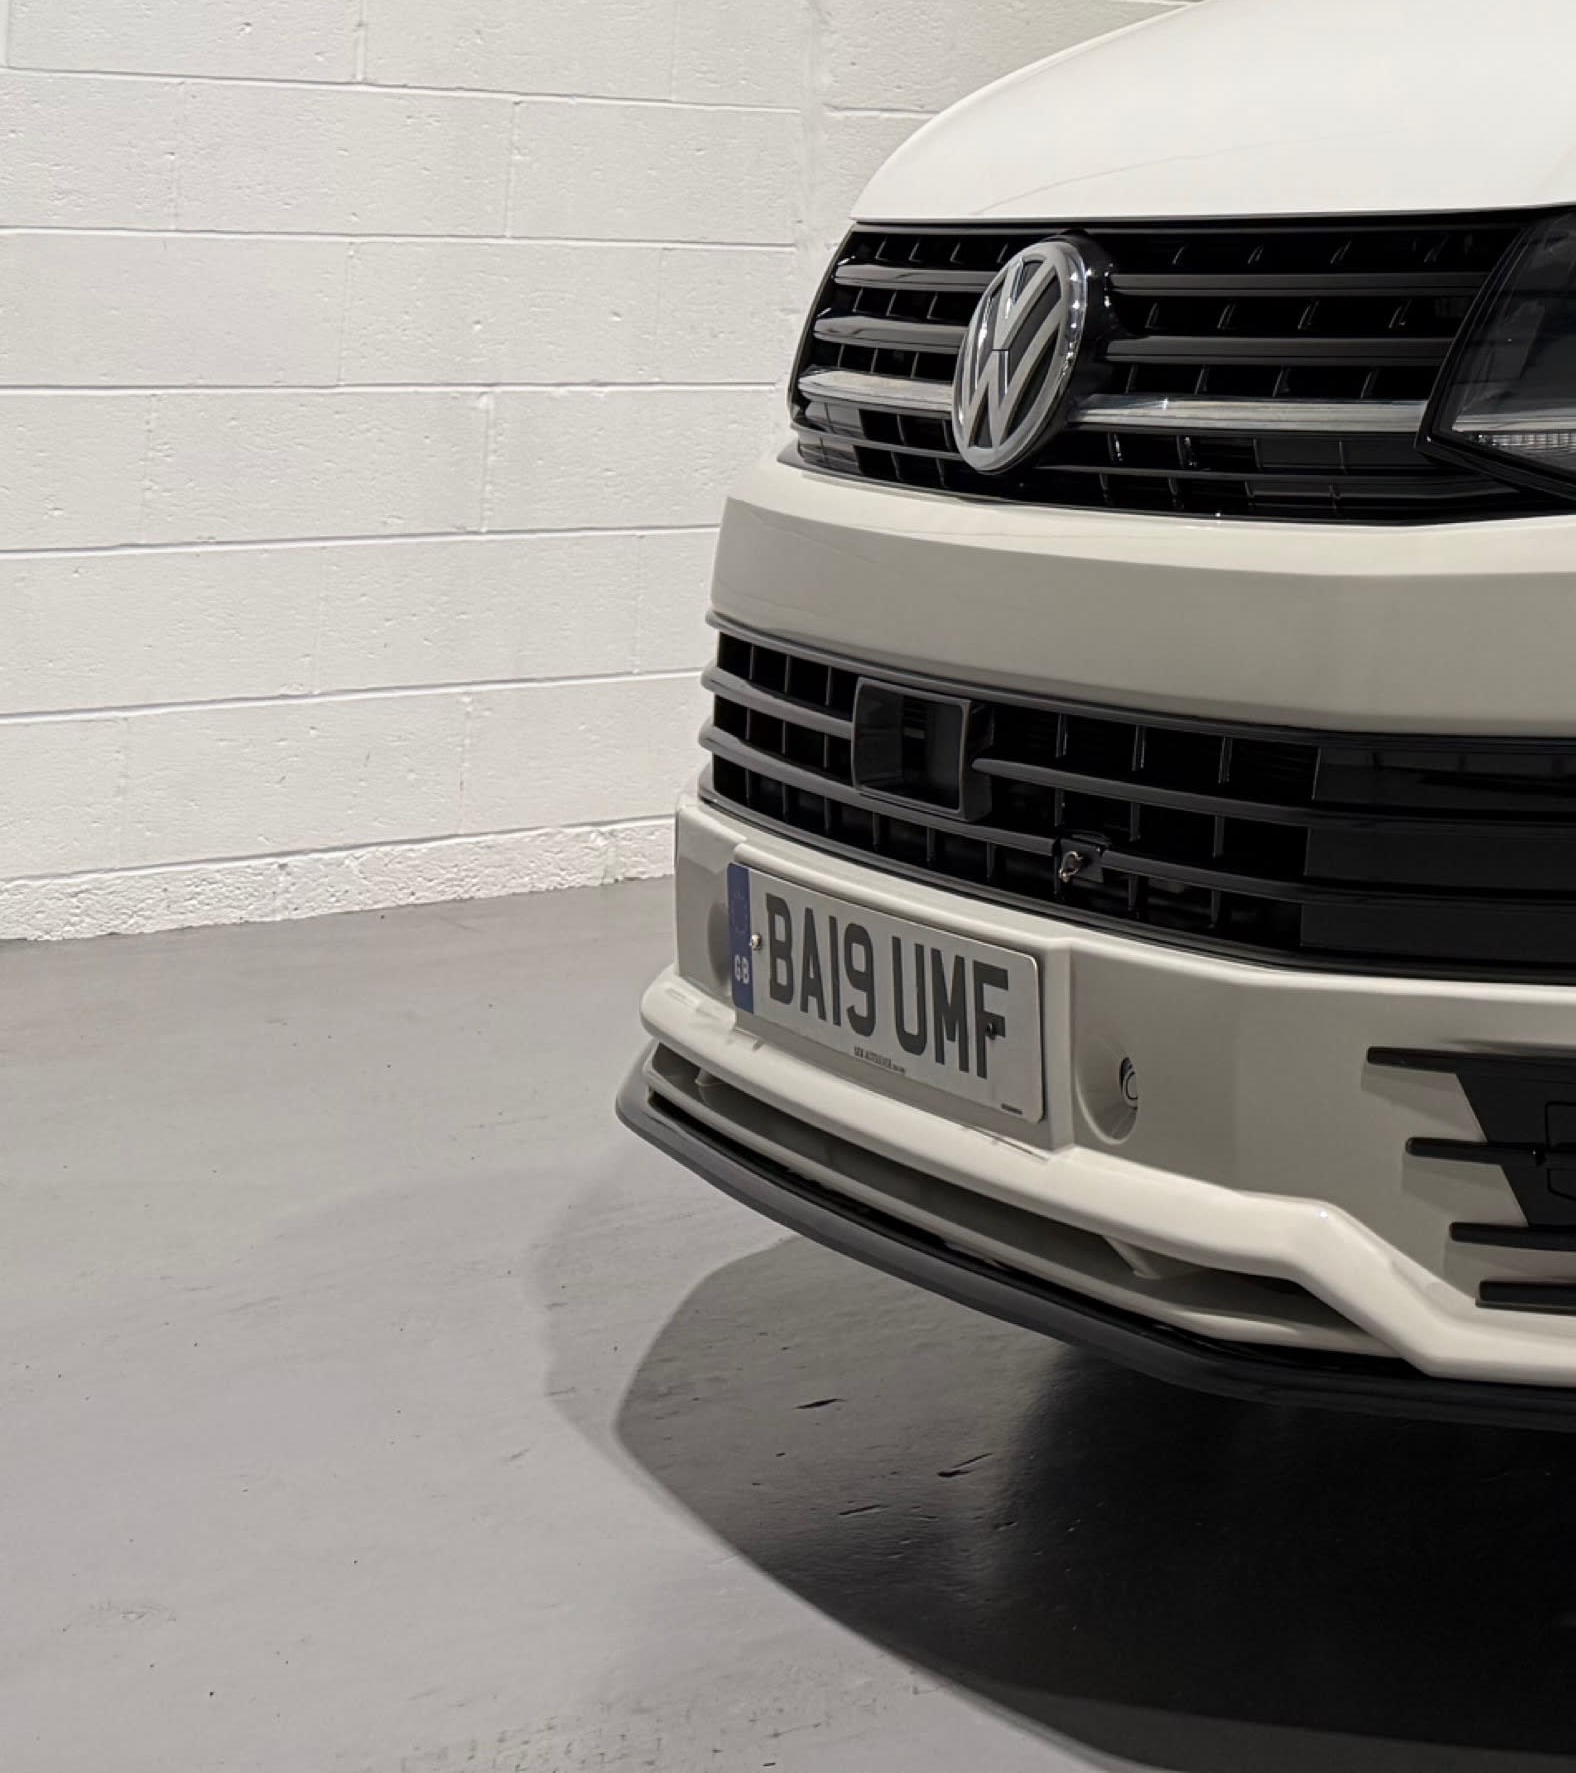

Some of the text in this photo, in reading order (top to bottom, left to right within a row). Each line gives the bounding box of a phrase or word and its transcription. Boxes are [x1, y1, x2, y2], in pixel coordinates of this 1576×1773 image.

[734, 954, 751, 985] GB
[765, 892, 1010, 1080] BA19 UMF
